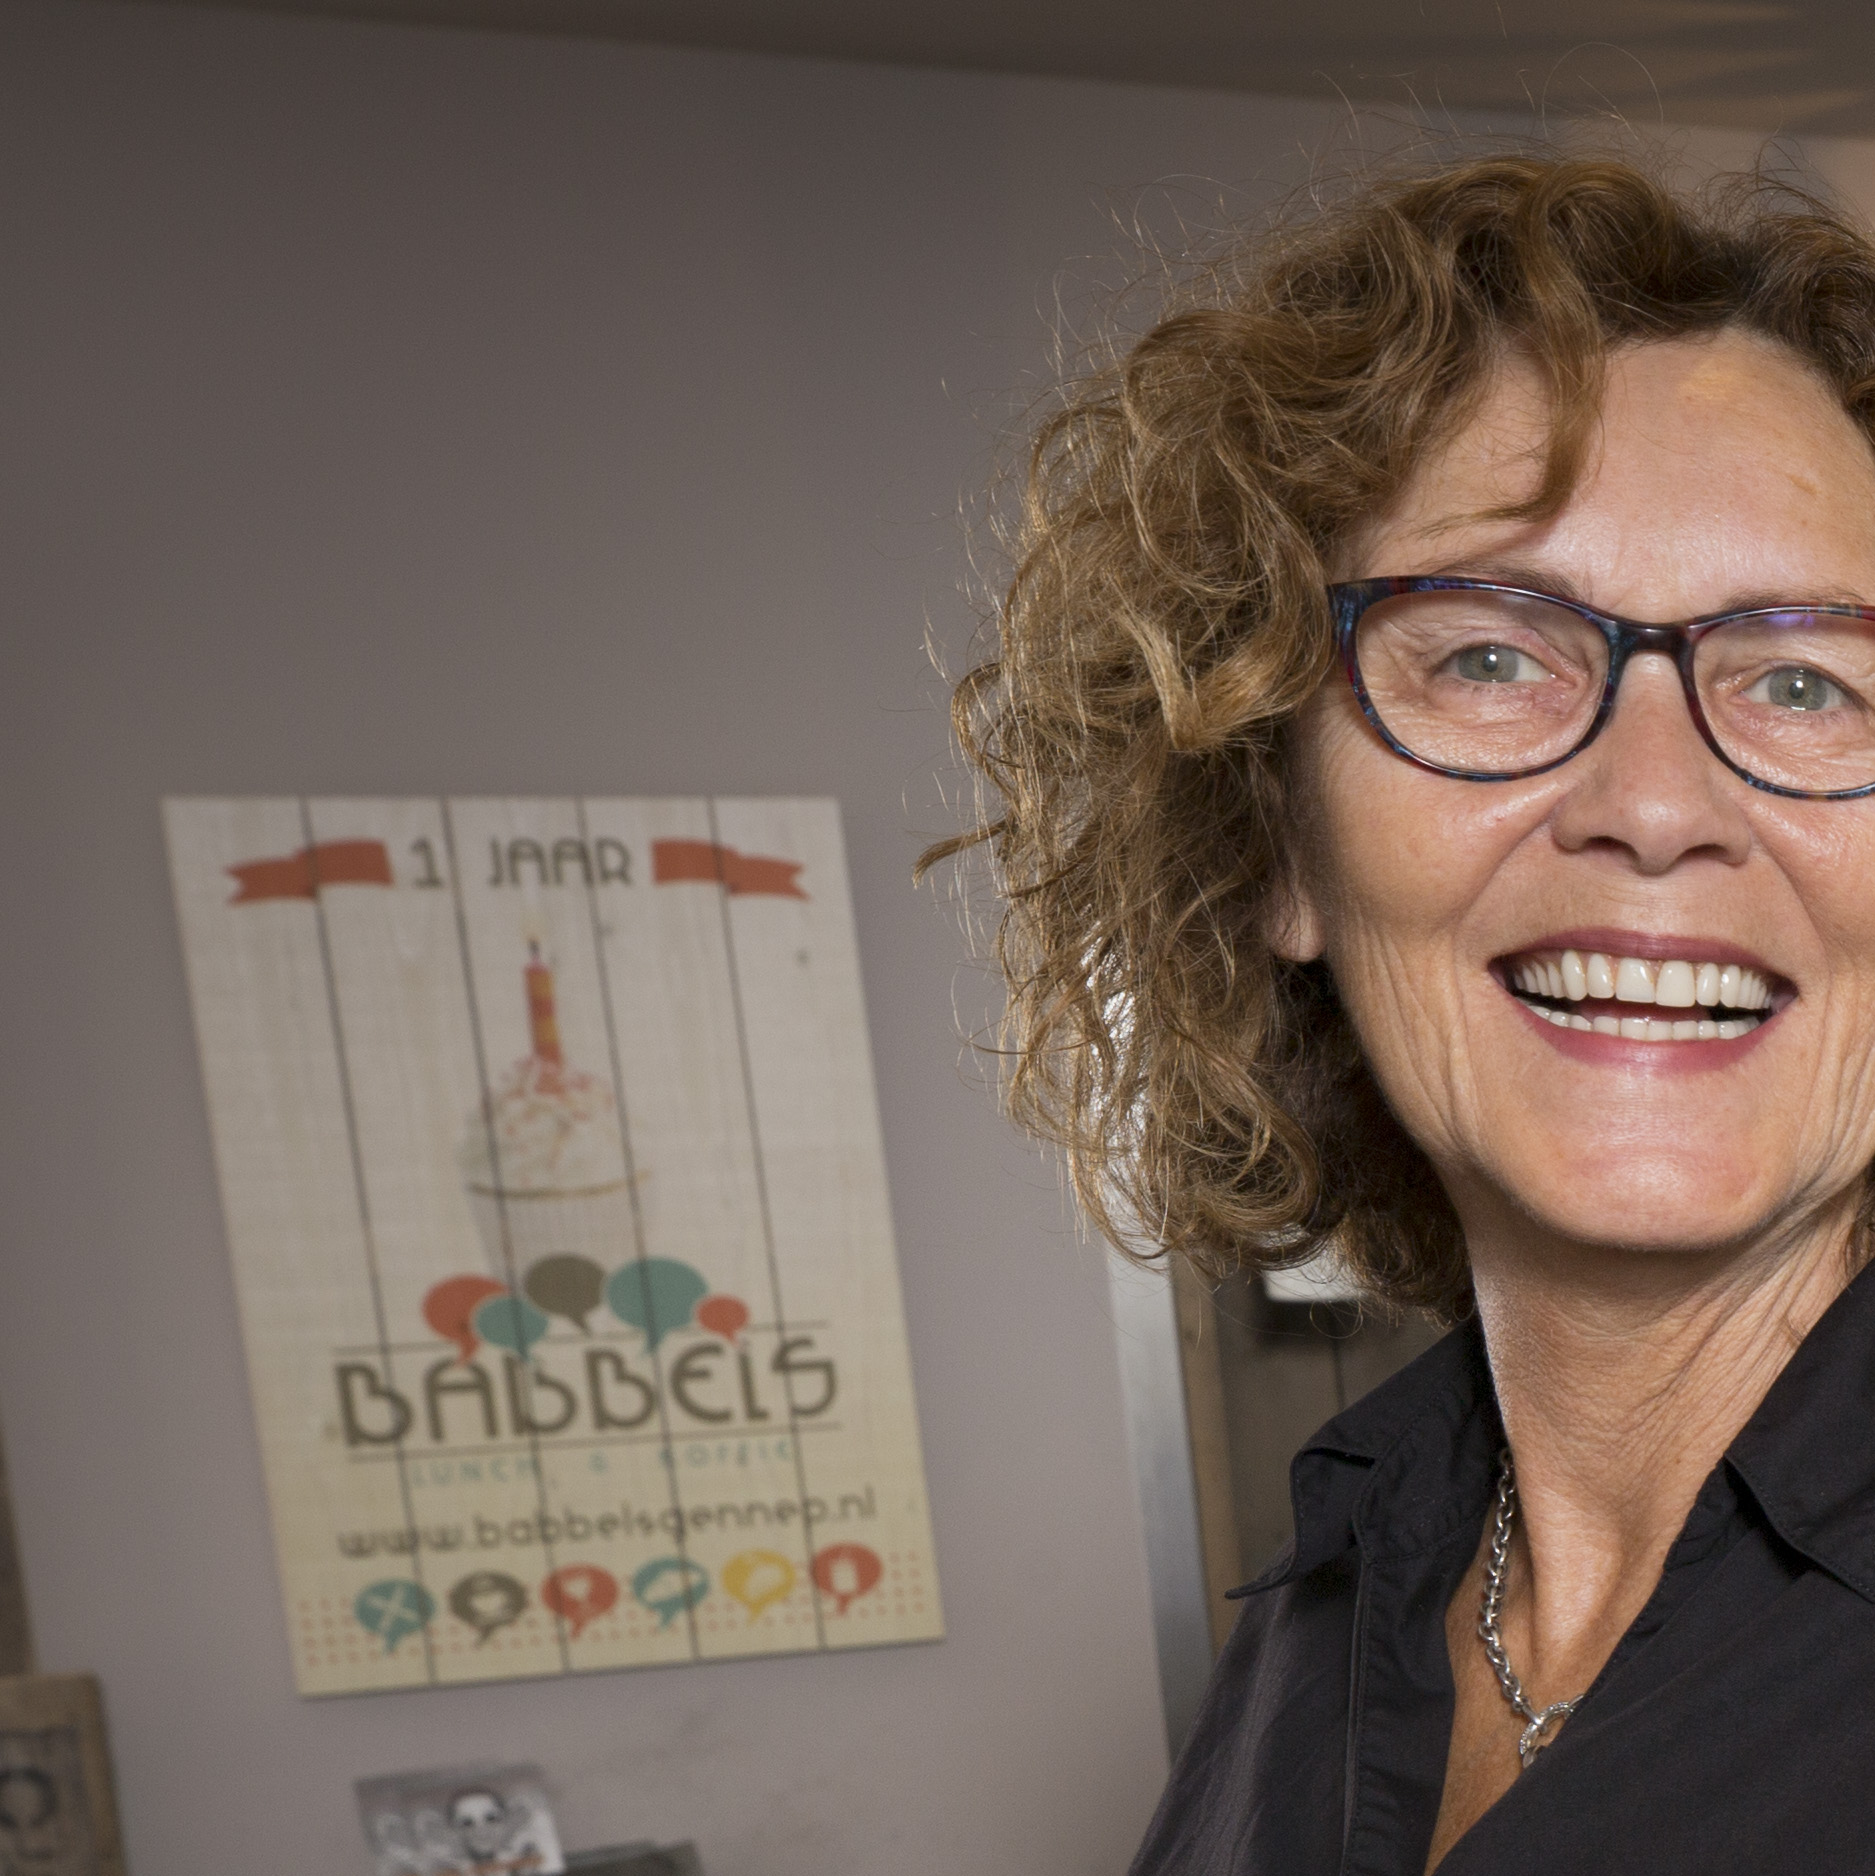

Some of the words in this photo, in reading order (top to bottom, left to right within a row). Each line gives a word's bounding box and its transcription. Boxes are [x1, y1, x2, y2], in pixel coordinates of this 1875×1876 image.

[408, 837, 446, 889] 1
[486, 836, 634, 888] JAAR
[335, 1485, 878, 1559] www.babbelsgennep.nl
